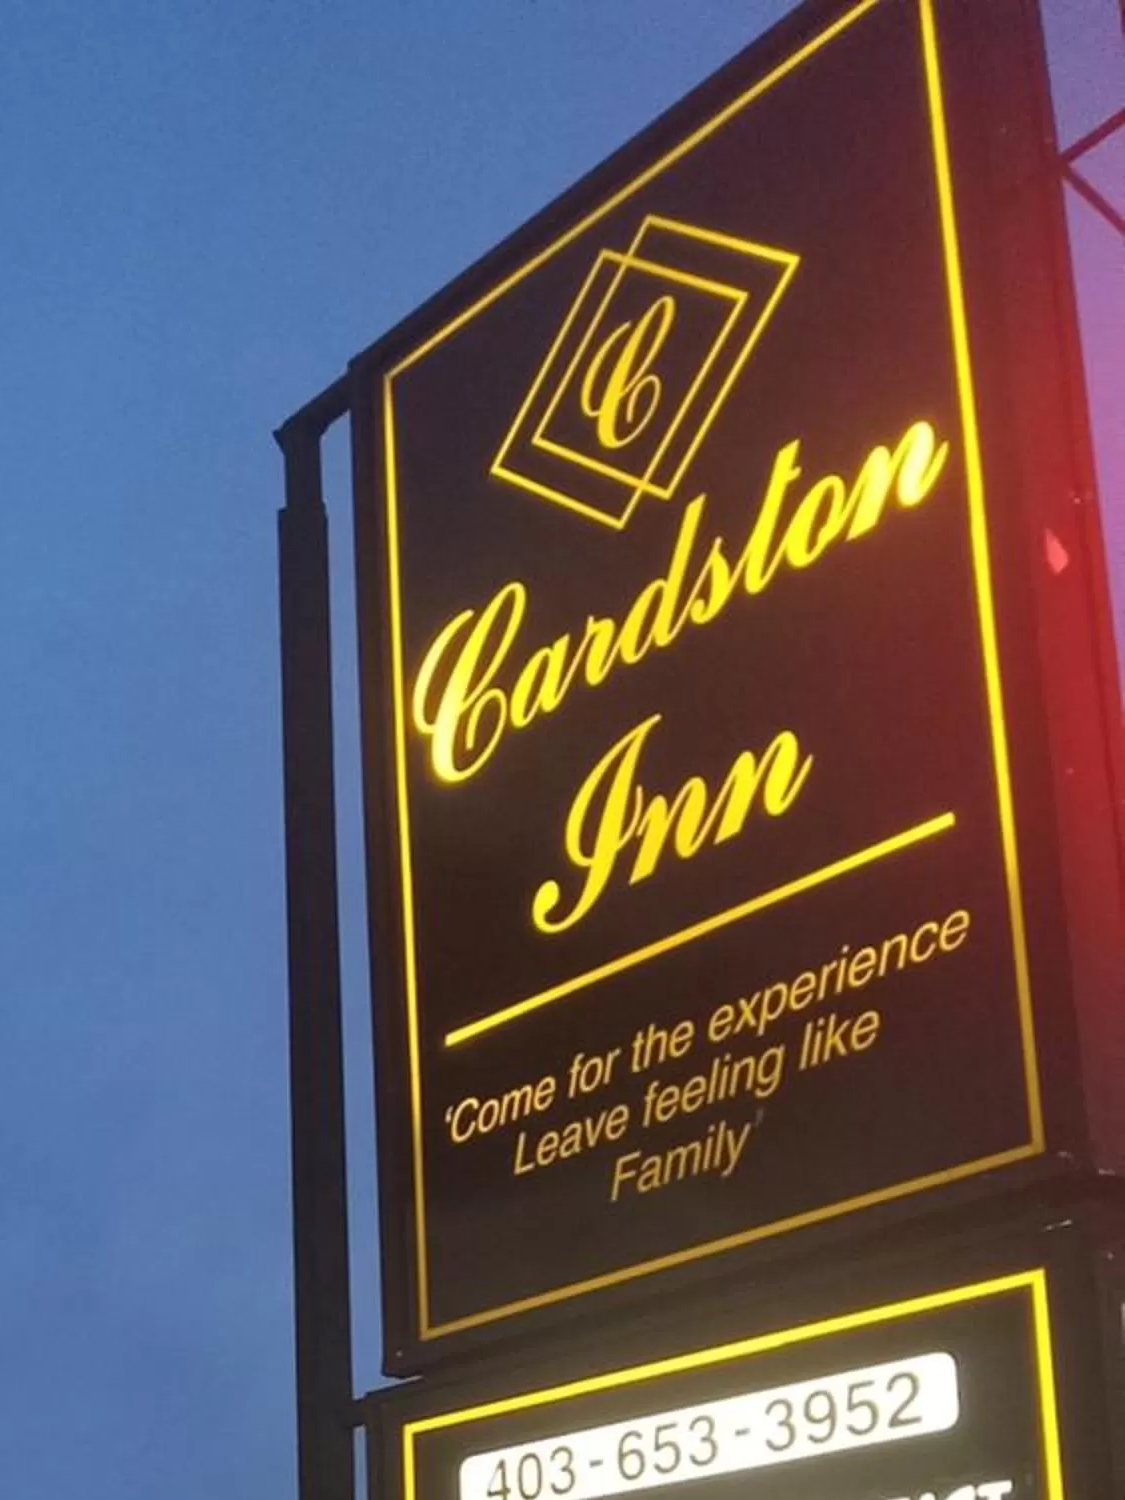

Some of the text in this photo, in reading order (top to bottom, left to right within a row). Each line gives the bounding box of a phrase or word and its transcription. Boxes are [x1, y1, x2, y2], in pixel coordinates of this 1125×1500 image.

[412, 421, 952, 783] Cardston
[531, 714, 814, 933] Inn
[513, 1009, 880, 1175] Leave feeling like
[567, 1050, 621, 1099] for
[632, 1018, 693, 1074] the
[709, 909, 971, 1037] experience
